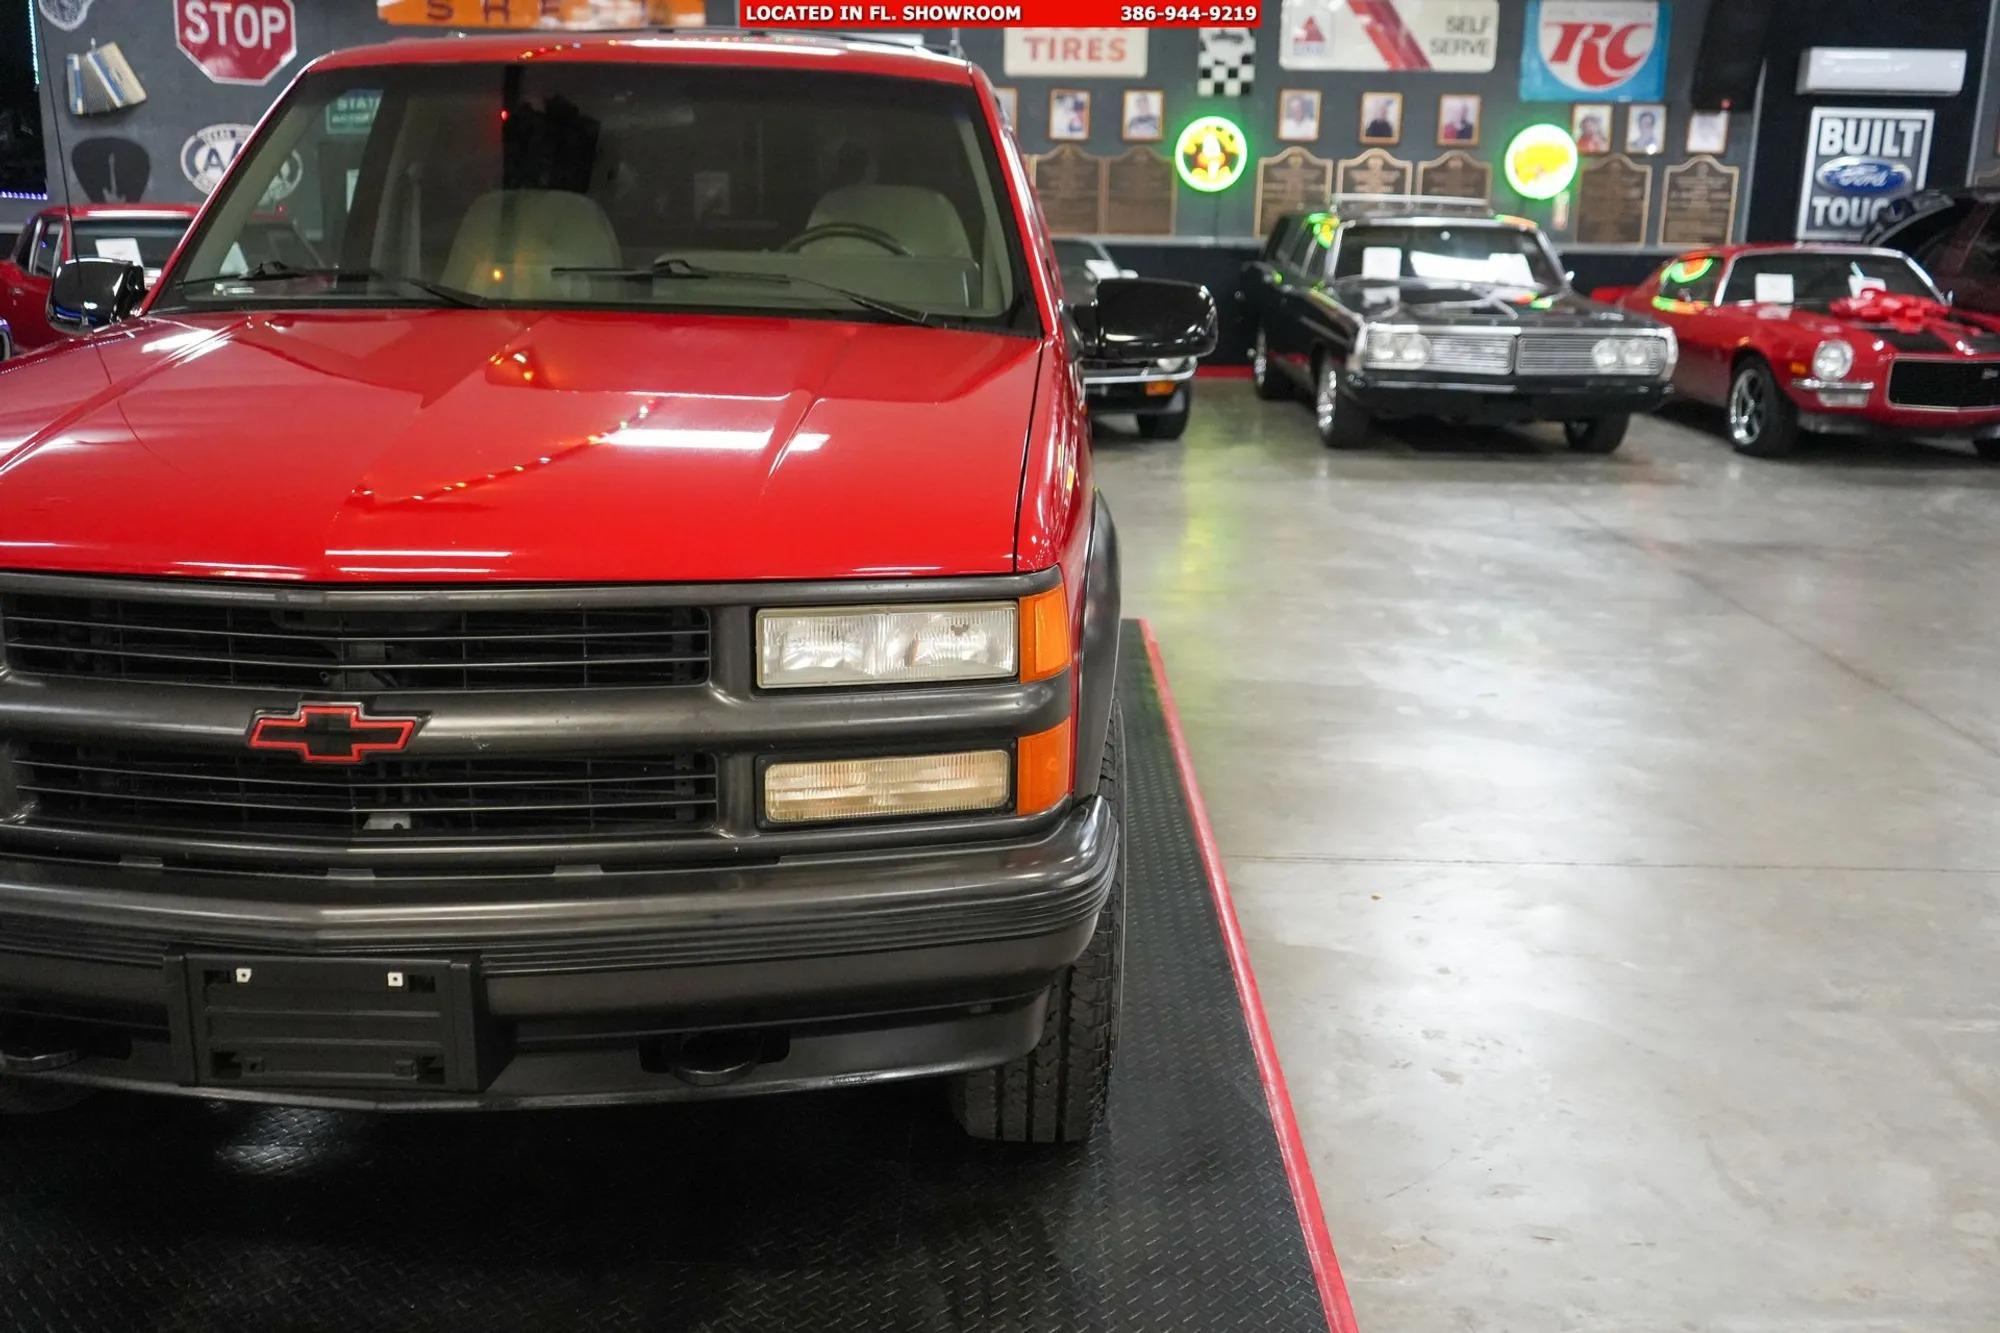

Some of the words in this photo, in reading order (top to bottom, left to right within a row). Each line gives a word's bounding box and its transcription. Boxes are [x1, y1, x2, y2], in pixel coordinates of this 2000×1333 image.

[185, 3, 287, 48] STOP
[1446, 15, 1492, 34] SELF
[1024, 37, 1128, 63] TIRES
[1430, 38, 1491, 57] SERVE
[1545, 22, 1652, 87] RC
[1818, 118, 1924, 157] BUILT
[1838, 165, 1890, 187] Ford
